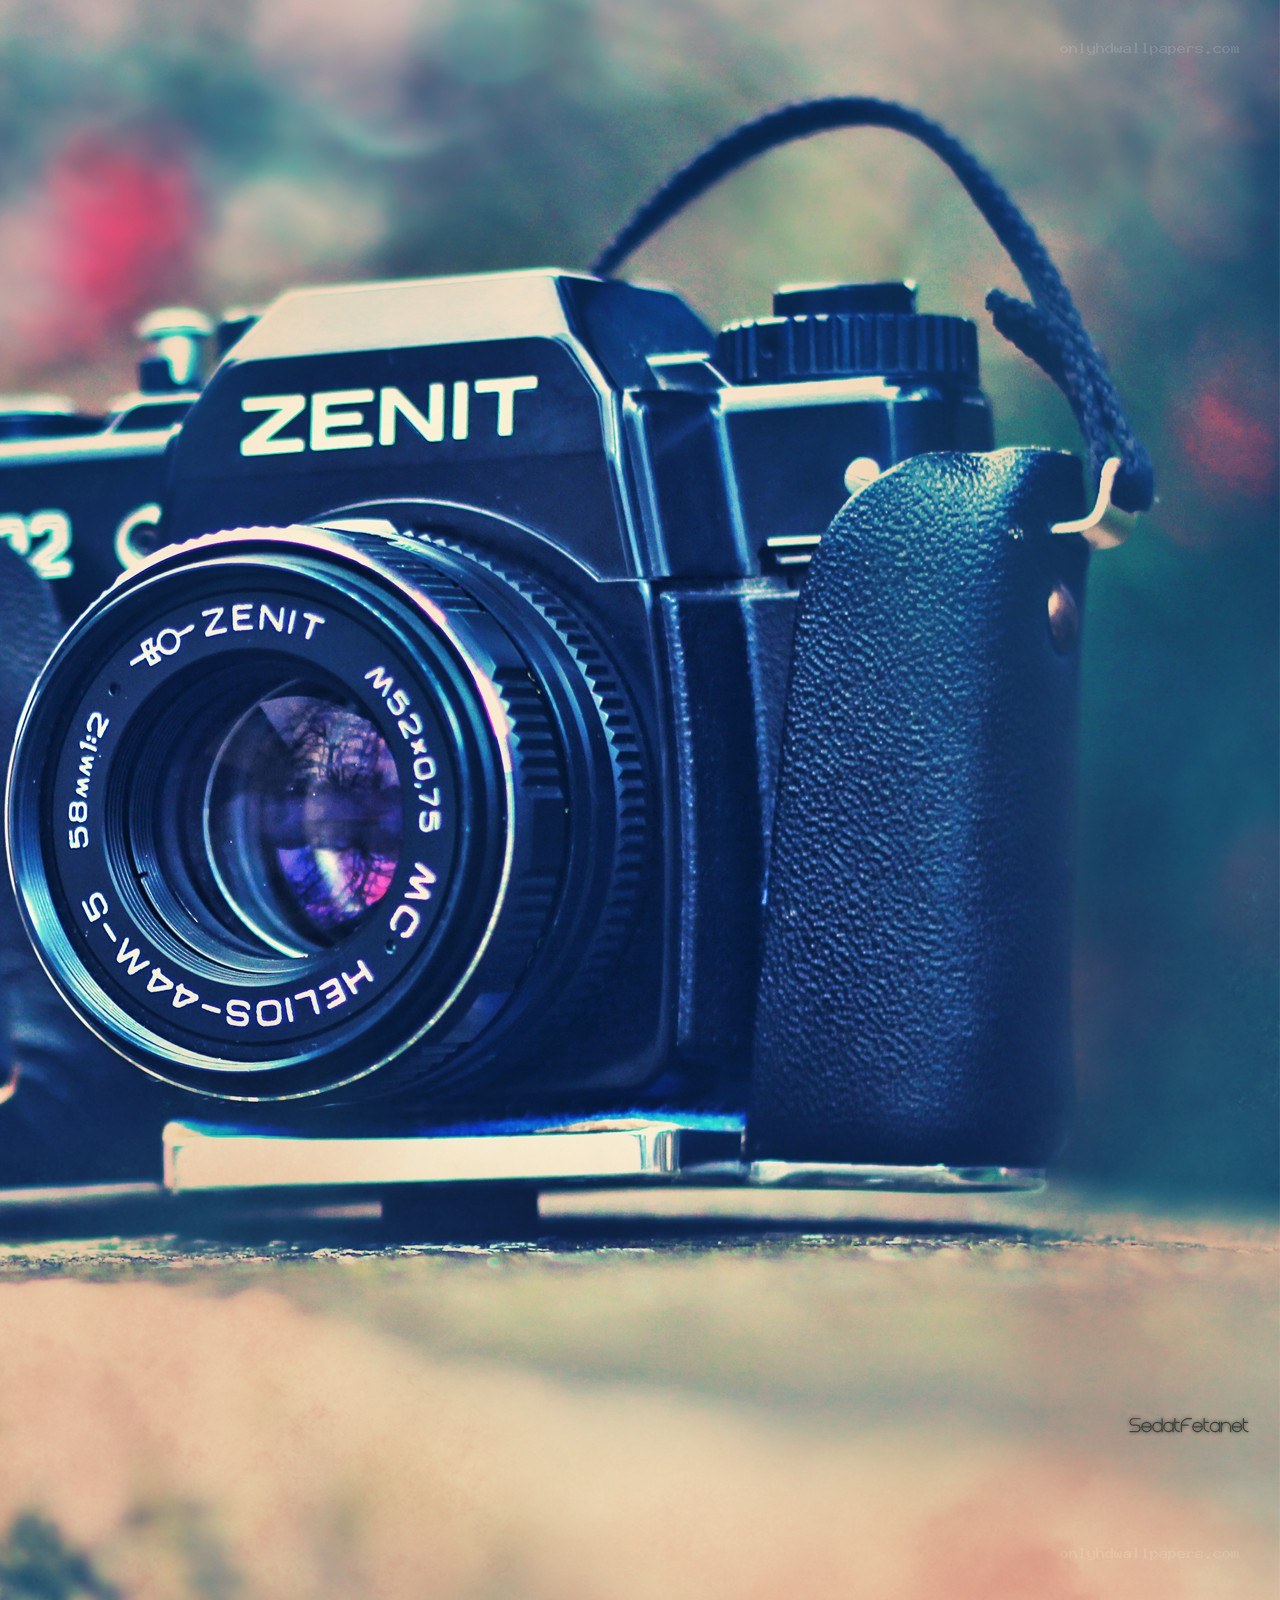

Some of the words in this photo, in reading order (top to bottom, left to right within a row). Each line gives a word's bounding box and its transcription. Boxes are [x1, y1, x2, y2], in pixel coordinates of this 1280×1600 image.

[240, 375, 539, 457] ZENIT
[201, 603, 326, 640] ZENIT
[389, 862, 437, 939] MC
